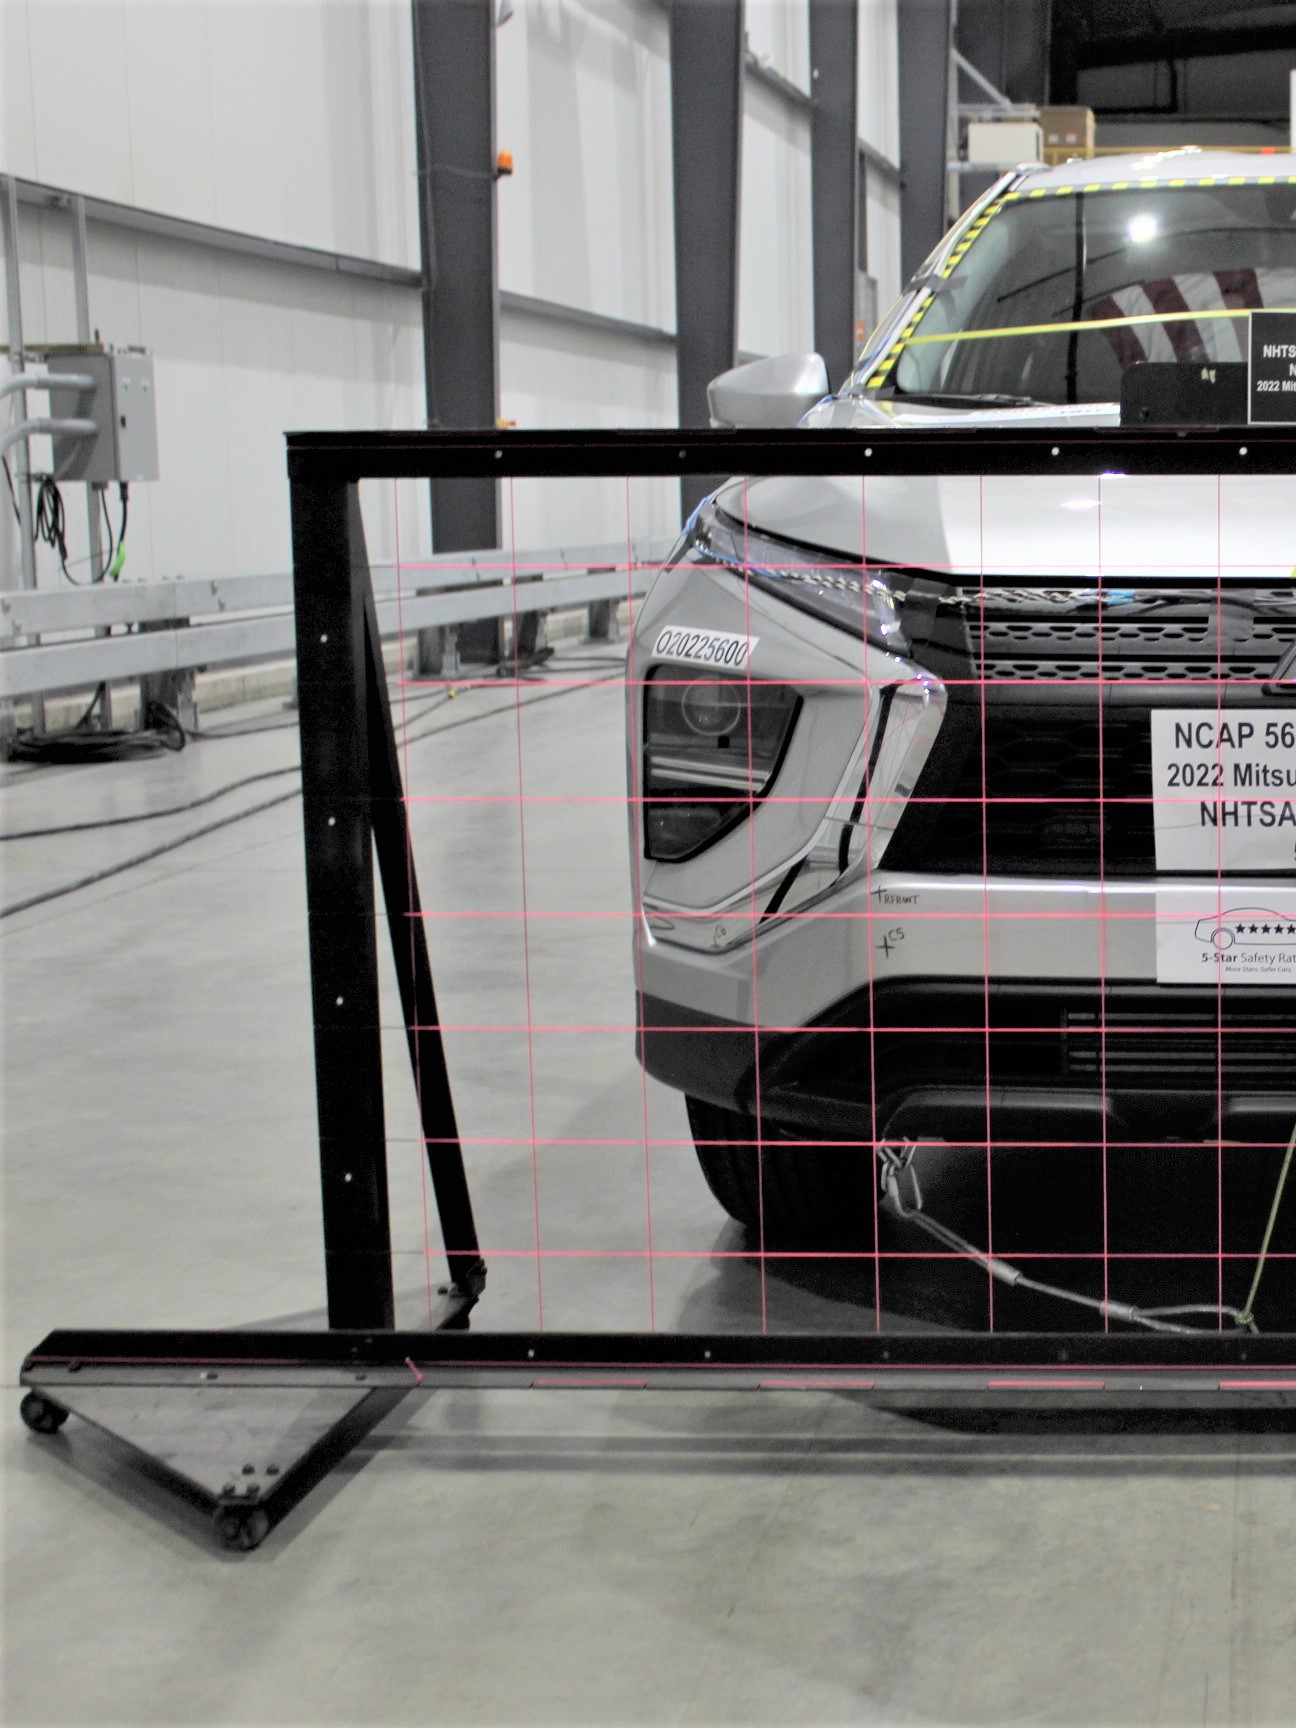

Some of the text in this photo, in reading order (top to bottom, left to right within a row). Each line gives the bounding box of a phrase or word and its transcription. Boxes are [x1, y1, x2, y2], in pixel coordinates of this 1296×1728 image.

[1257, 380, 1280, 392] 2022
[1175, 722, 1254, 749] NCAP
[1167, 763, 1224, 787] 2022
[888, 927, 905, 942] C5
[1201, 952, 1238, 963] 5-Star
[1240, 952, 1275, 965] Safety
